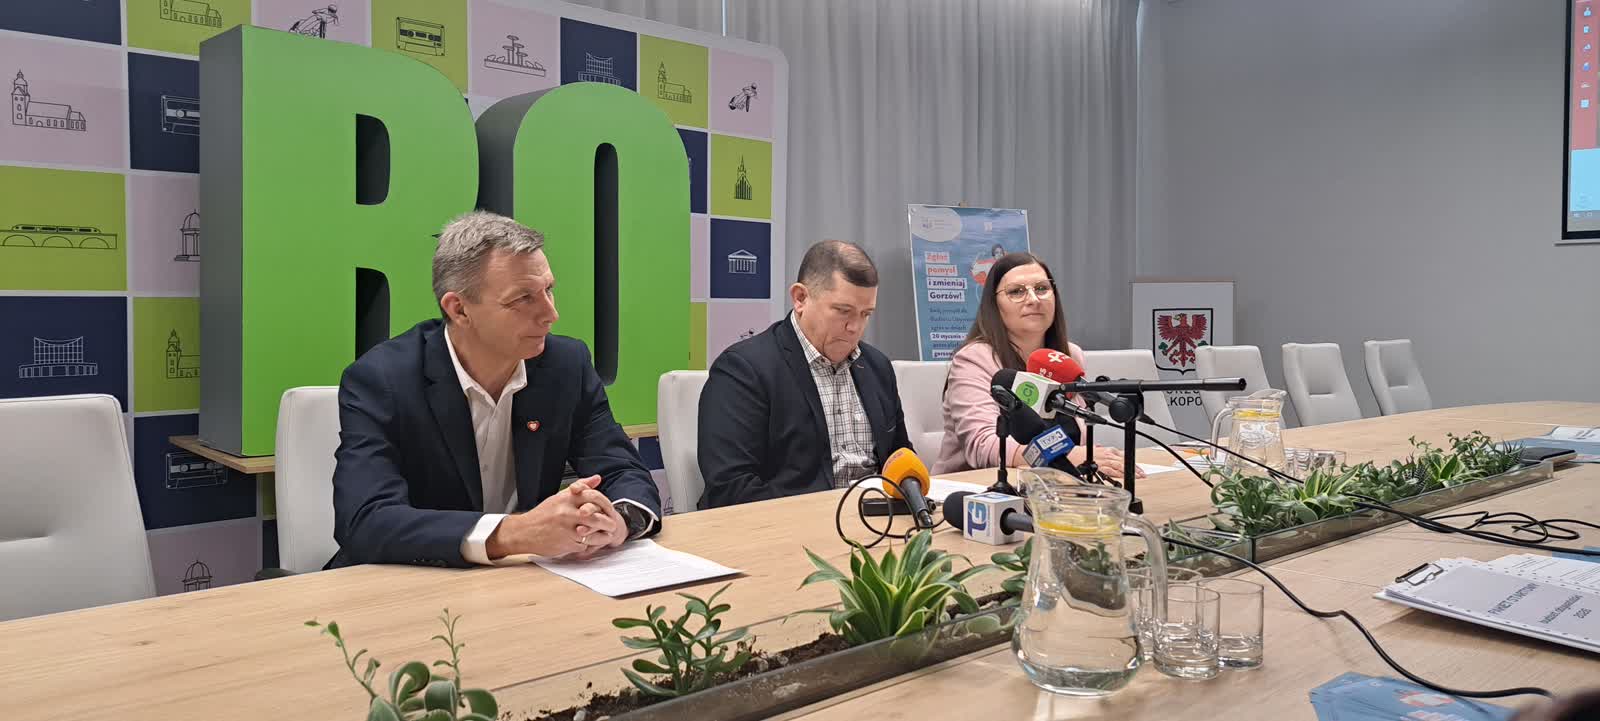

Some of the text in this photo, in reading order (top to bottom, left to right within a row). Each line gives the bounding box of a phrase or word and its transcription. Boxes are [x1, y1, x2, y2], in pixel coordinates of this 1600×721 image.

[927, 265, 956, 276] pomysł
[933, 278, 966, 289] zmieniaj
[929, 291, 962, 300] Gorzów!
[1167, 396, 1203, 406] KOPO
